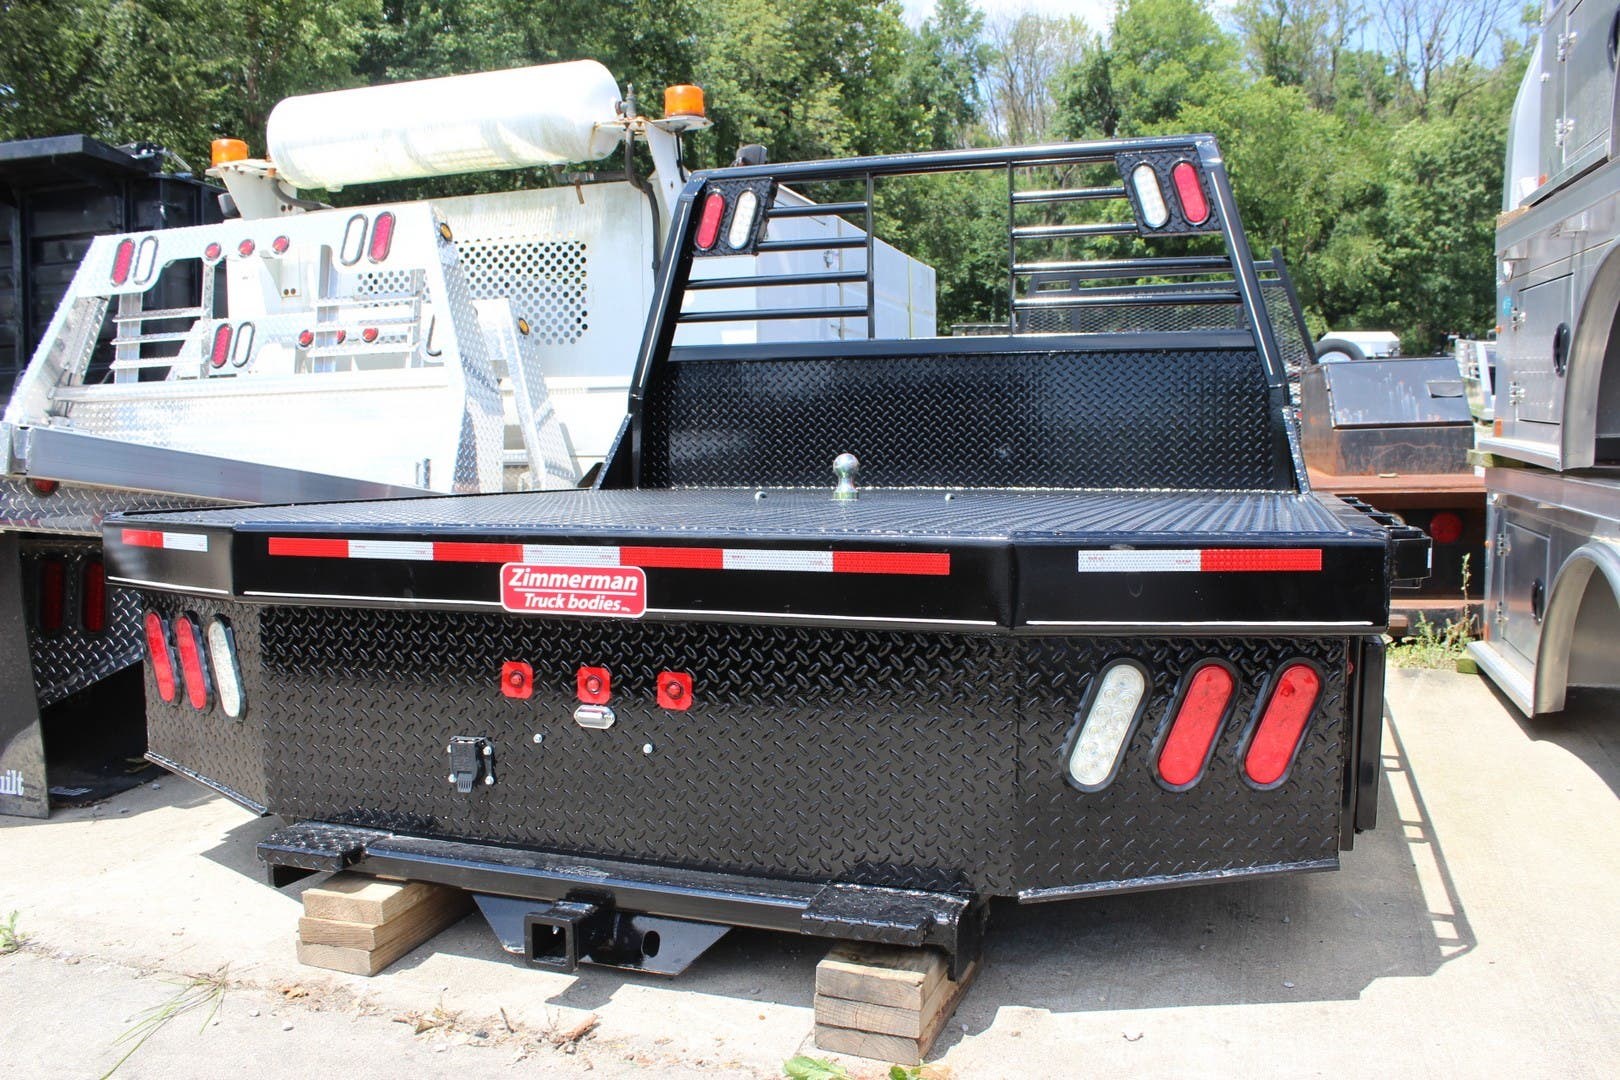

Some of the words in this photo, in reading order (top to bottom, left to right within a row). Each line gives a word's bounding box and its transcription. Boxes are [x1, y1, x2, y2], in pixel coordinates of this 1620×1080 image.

[508, 567, 638, 591] Zimmerman
[524, 592, 566, 609] Truck
[567, 594, 621, 611] bodies
